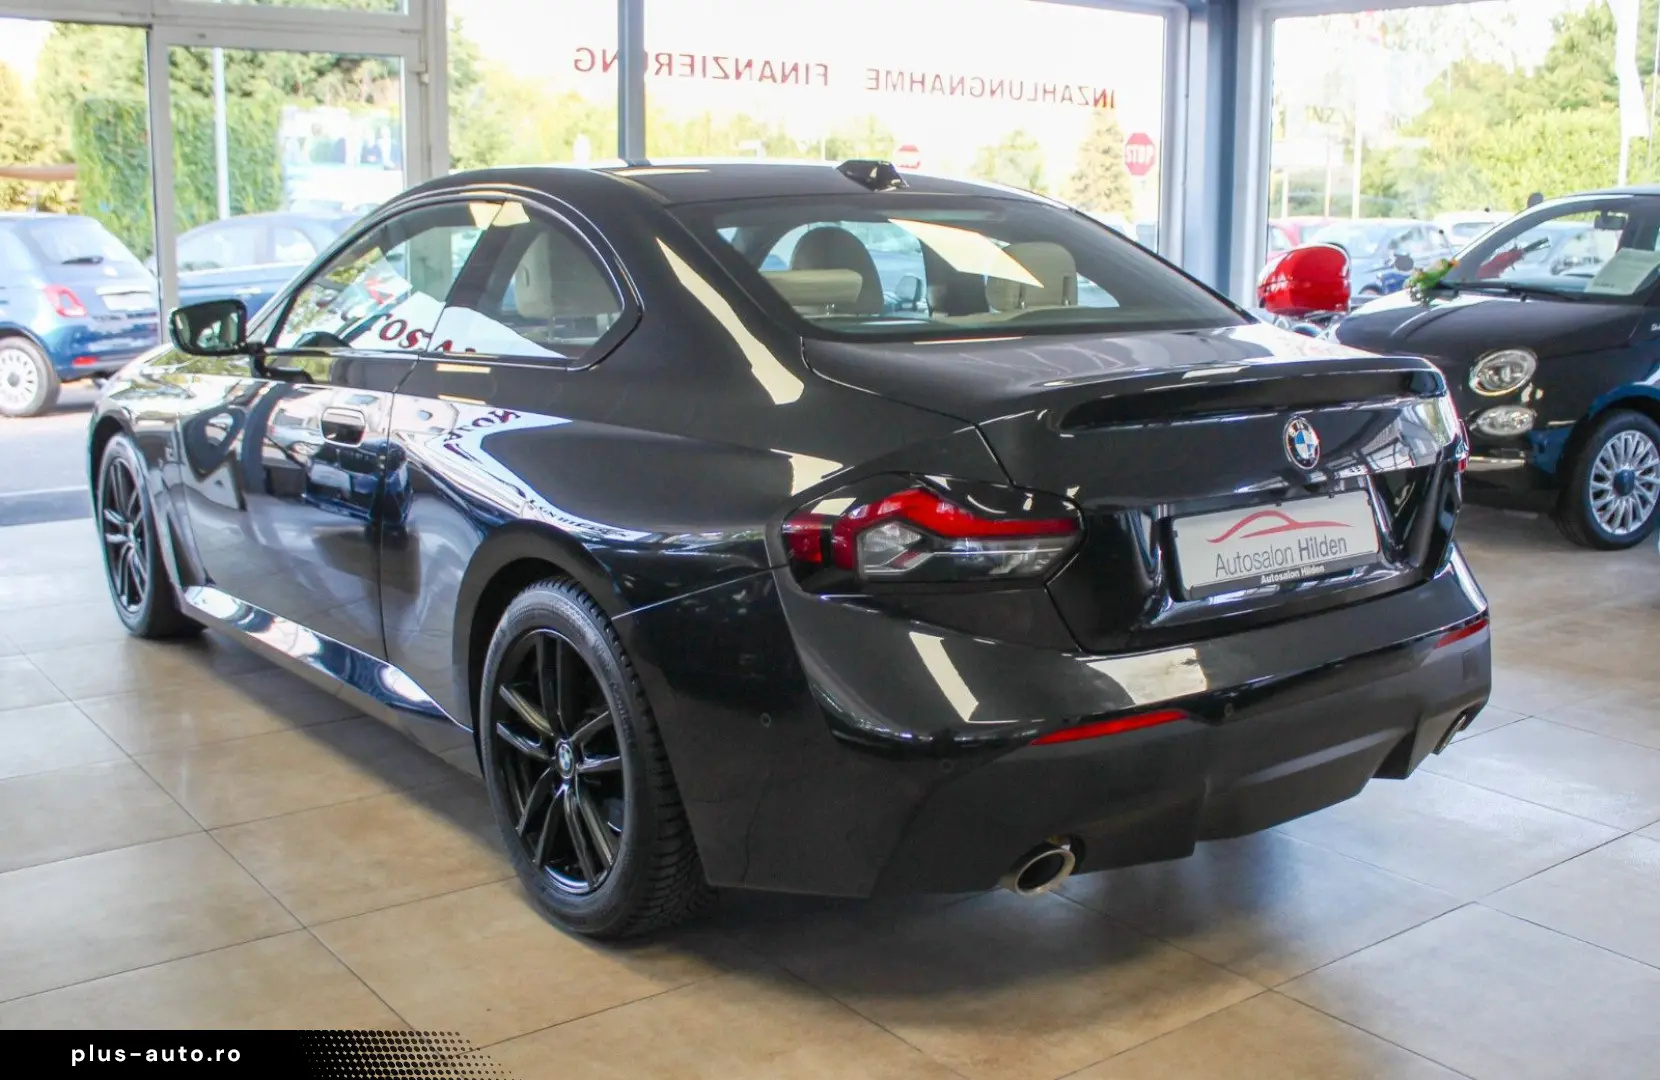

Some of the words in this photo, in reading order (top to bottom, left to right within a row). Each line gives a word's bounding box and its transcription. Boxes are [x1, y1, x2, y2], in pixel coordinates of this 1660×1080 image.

[1215, 543, 1294, 578] Autosalon
[1297, 534, 1348, 561] Hilden
[1260, 568, 1301, 585] Autosalon
[1300, 563, 1325, 577] Hilden
